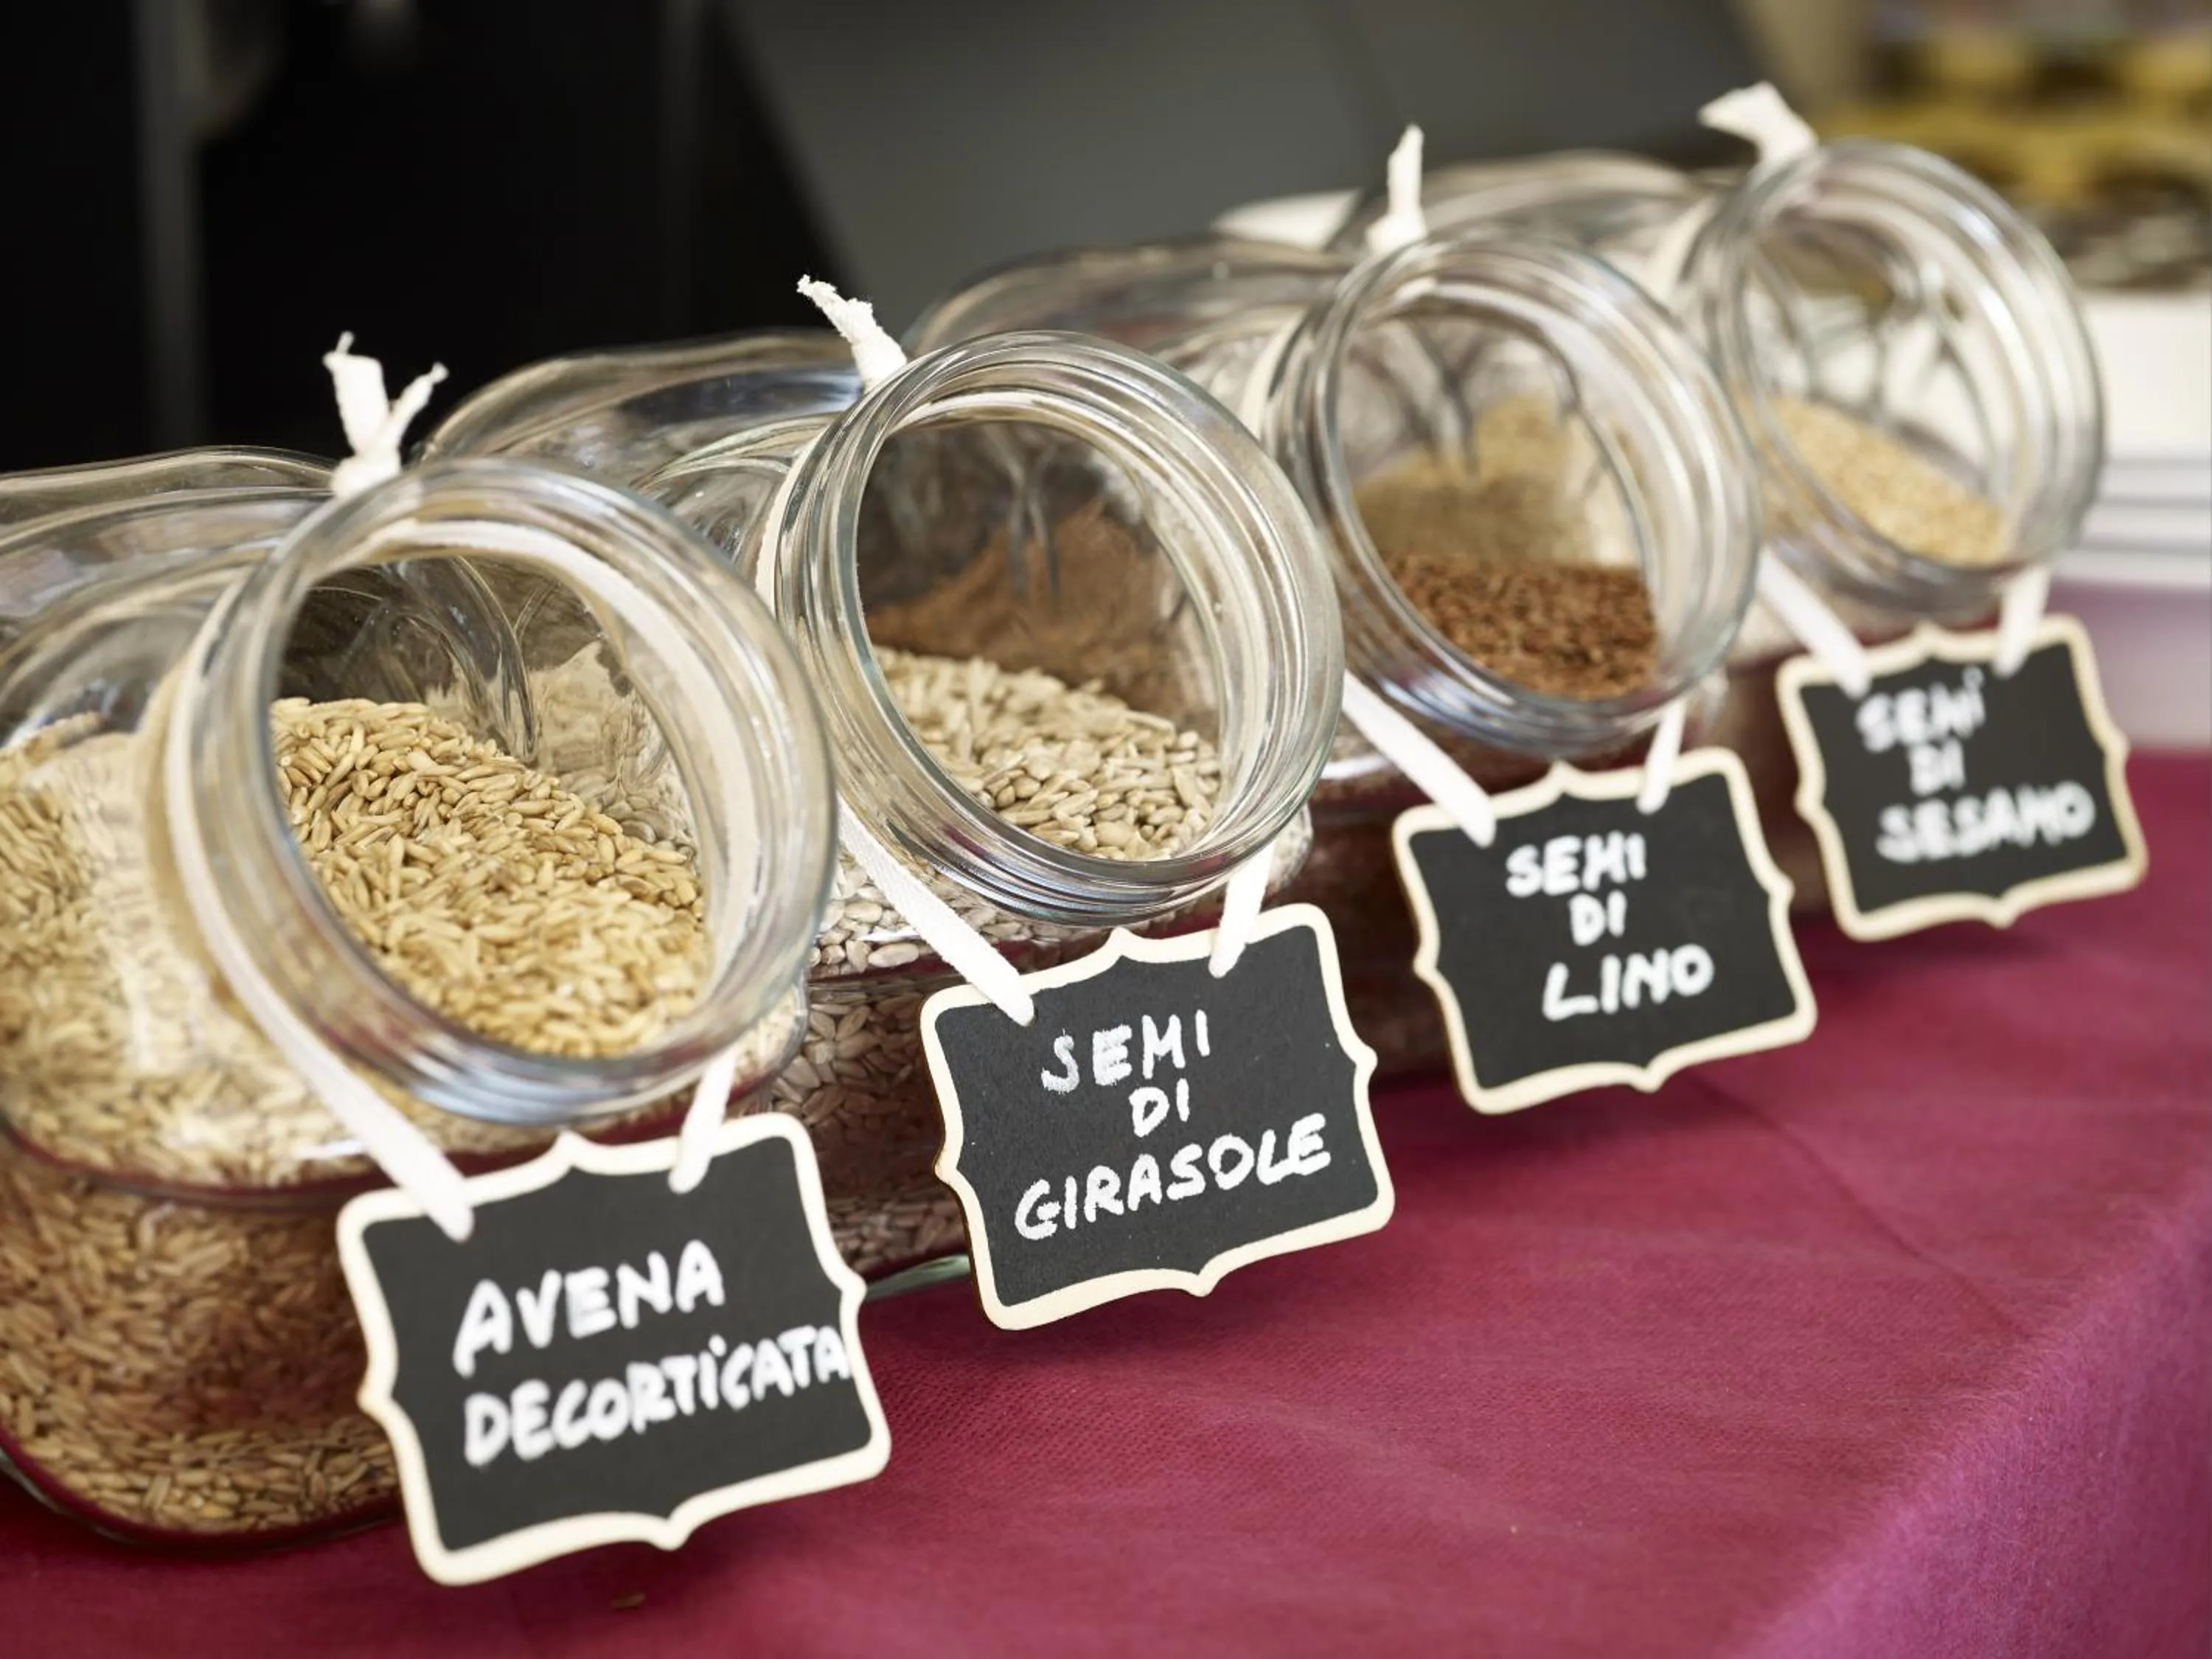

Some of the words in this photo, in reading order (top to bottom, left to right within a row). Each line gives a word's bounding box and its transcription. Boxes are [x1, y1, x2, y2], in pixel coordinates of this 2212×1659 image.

[1908, 737, 1965, 796] DI
[1877, 779, 2096, 863] SESAMO
[1506, 830, 1646, 897] SEMI
[1569, 891, 1627, 946] DI
[1543, 944, 1714, 1020] LINO
[1041, 1009, 1211, 1093] SEMI
[1129, 1078, 1189, 1138] DI
[1015, 1113, 1331, 1240] GIRASOLE
[453, 1239, 725, 1378] AVENA
